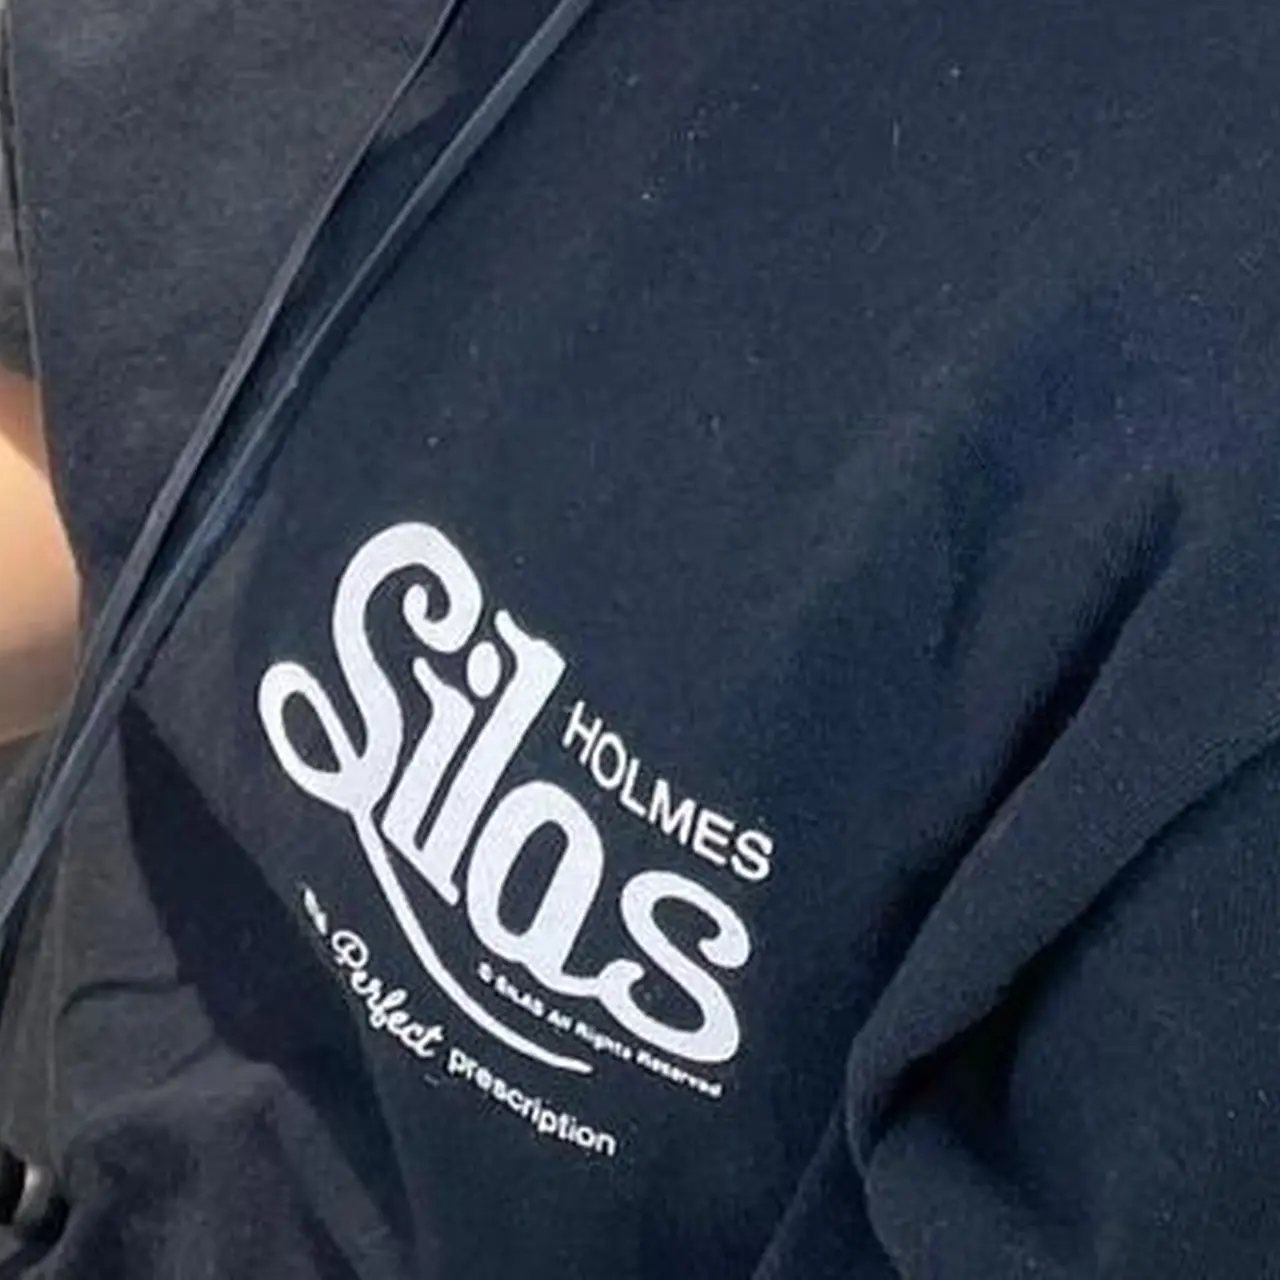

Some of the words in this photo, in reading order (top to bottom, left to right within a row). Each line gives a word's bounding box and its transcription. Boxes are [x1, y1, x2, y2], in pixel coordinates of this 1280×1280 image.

[258, 521, 751, 1074] Silas
[561, 701, 774, 881] HOLMES
[330, 928, 445, 1058] Perfect
[446, 1047, 617, 1157] prescription
